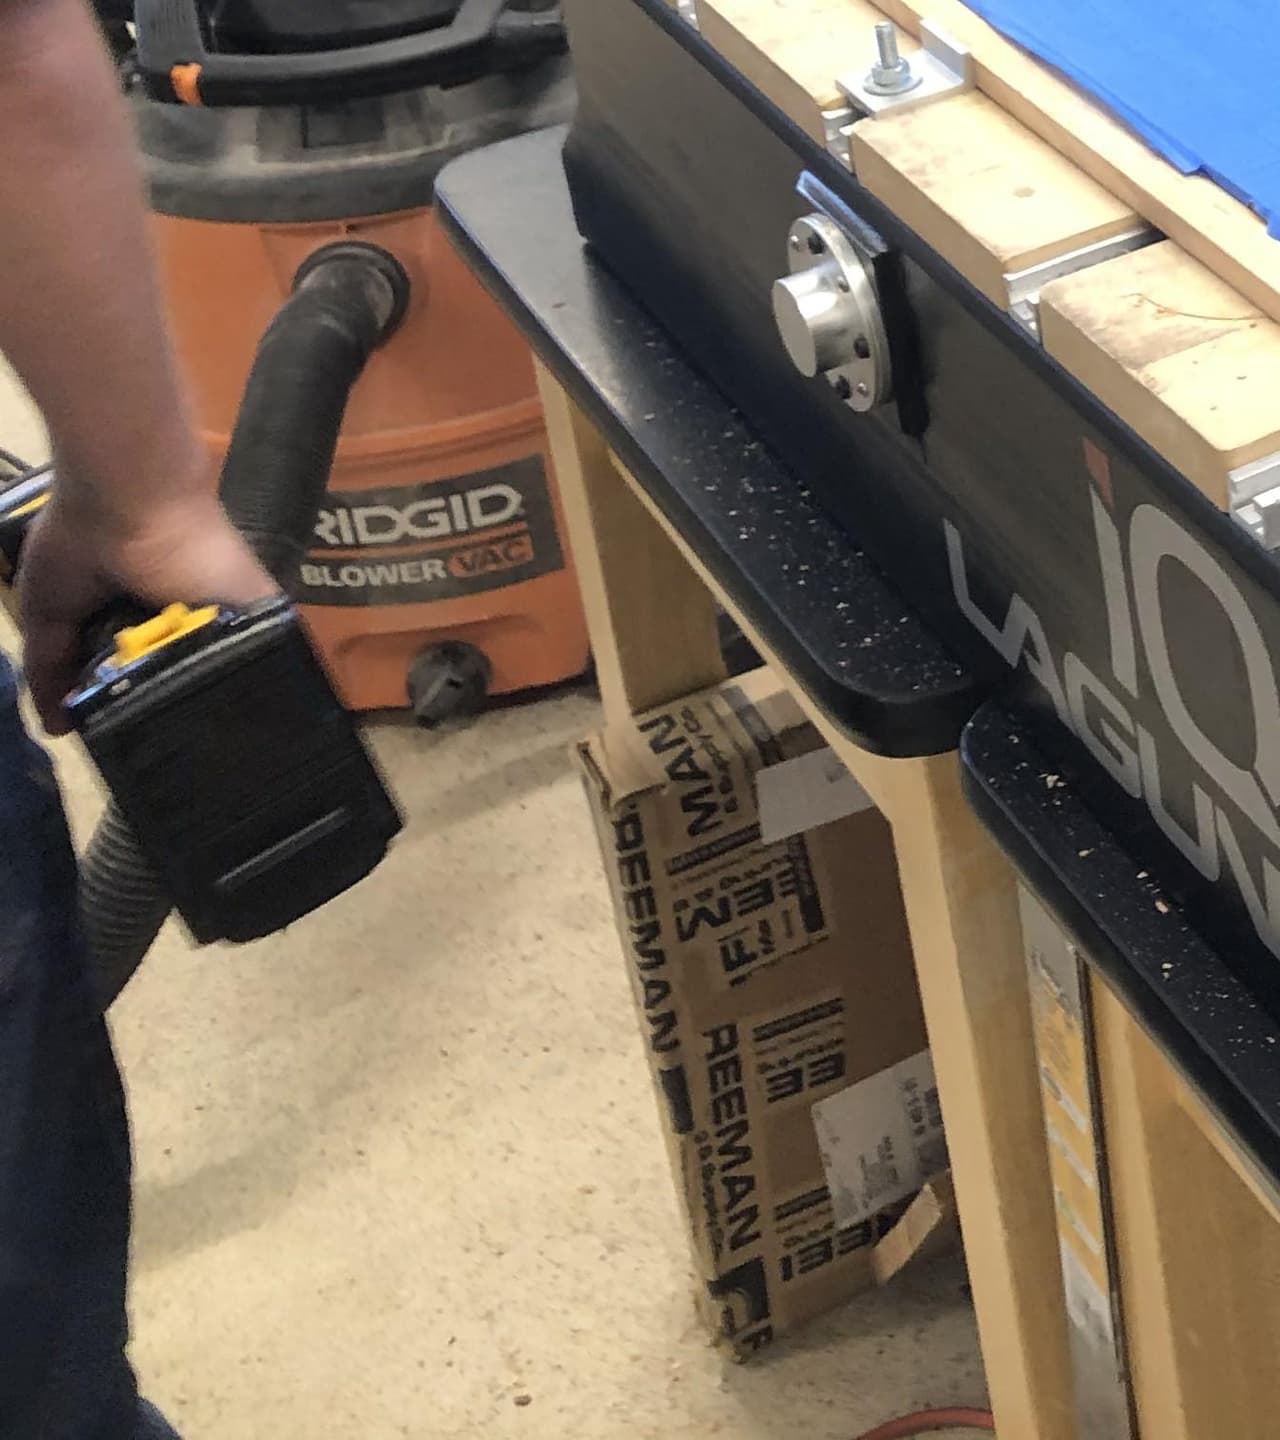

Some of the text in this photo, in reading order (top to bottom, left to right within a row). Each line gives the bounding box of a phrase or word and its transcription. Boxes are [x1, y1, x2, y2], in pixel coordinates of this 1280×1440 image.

[315, 483, 525, 546] RIDGID
[300, 537, 528, 588] BLOWER VAC
